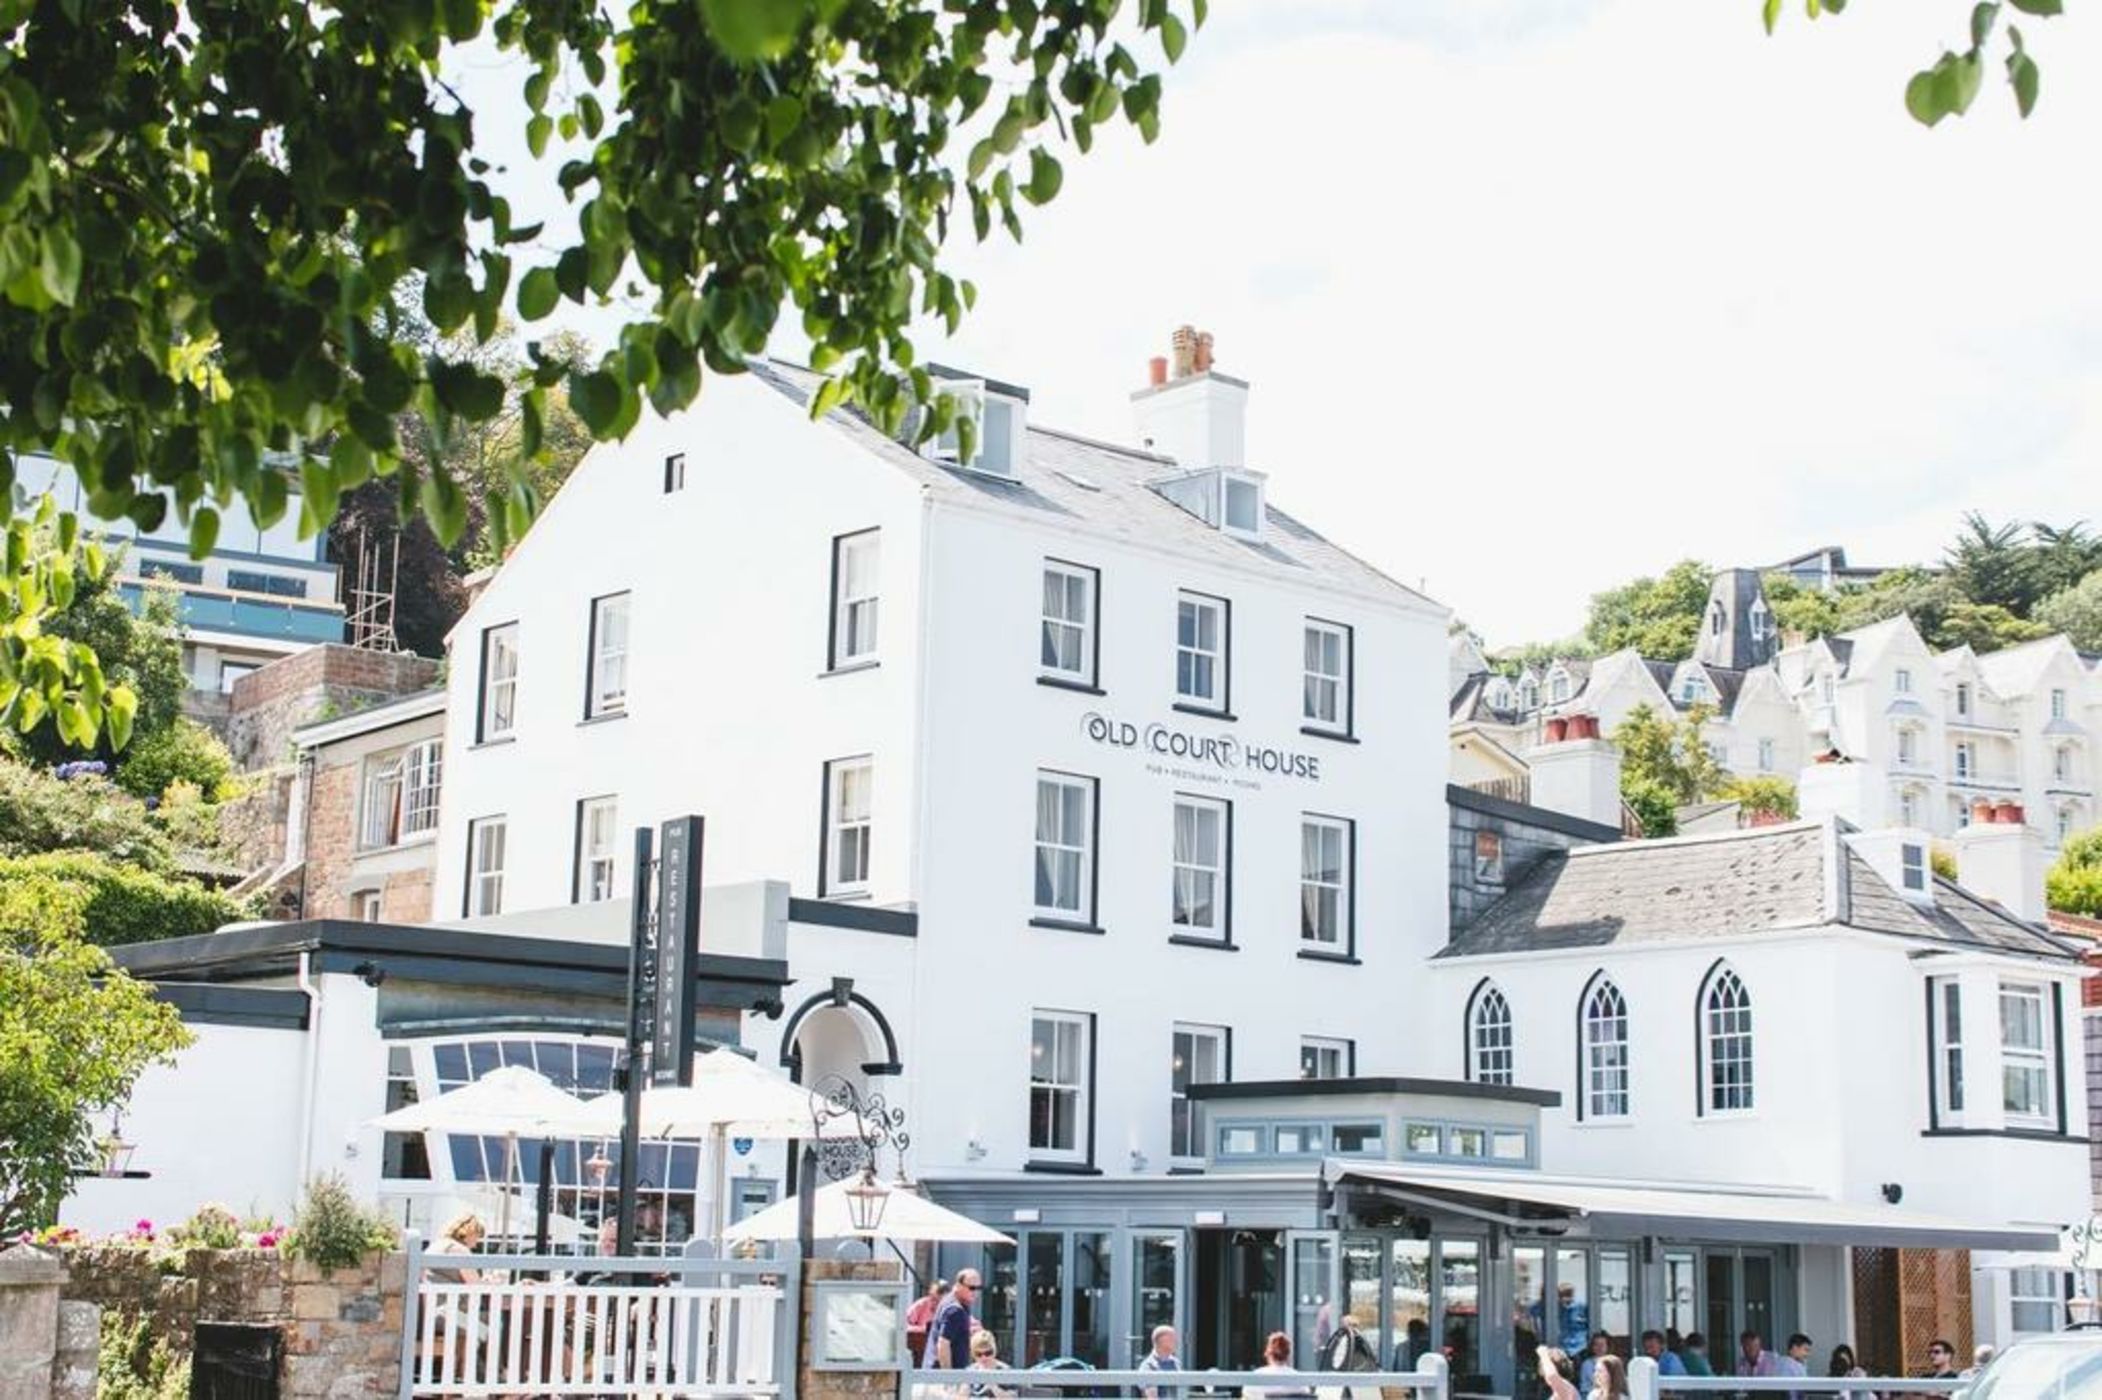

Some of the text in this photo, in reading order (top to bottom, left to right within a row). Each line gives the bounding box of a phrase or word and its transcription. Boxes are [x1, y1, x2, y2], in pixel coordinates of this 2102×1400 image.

[1087, 715, 1321, 780] OLD COURT HOUSE
[661, 848, 681, 1058] RESTAURANT
